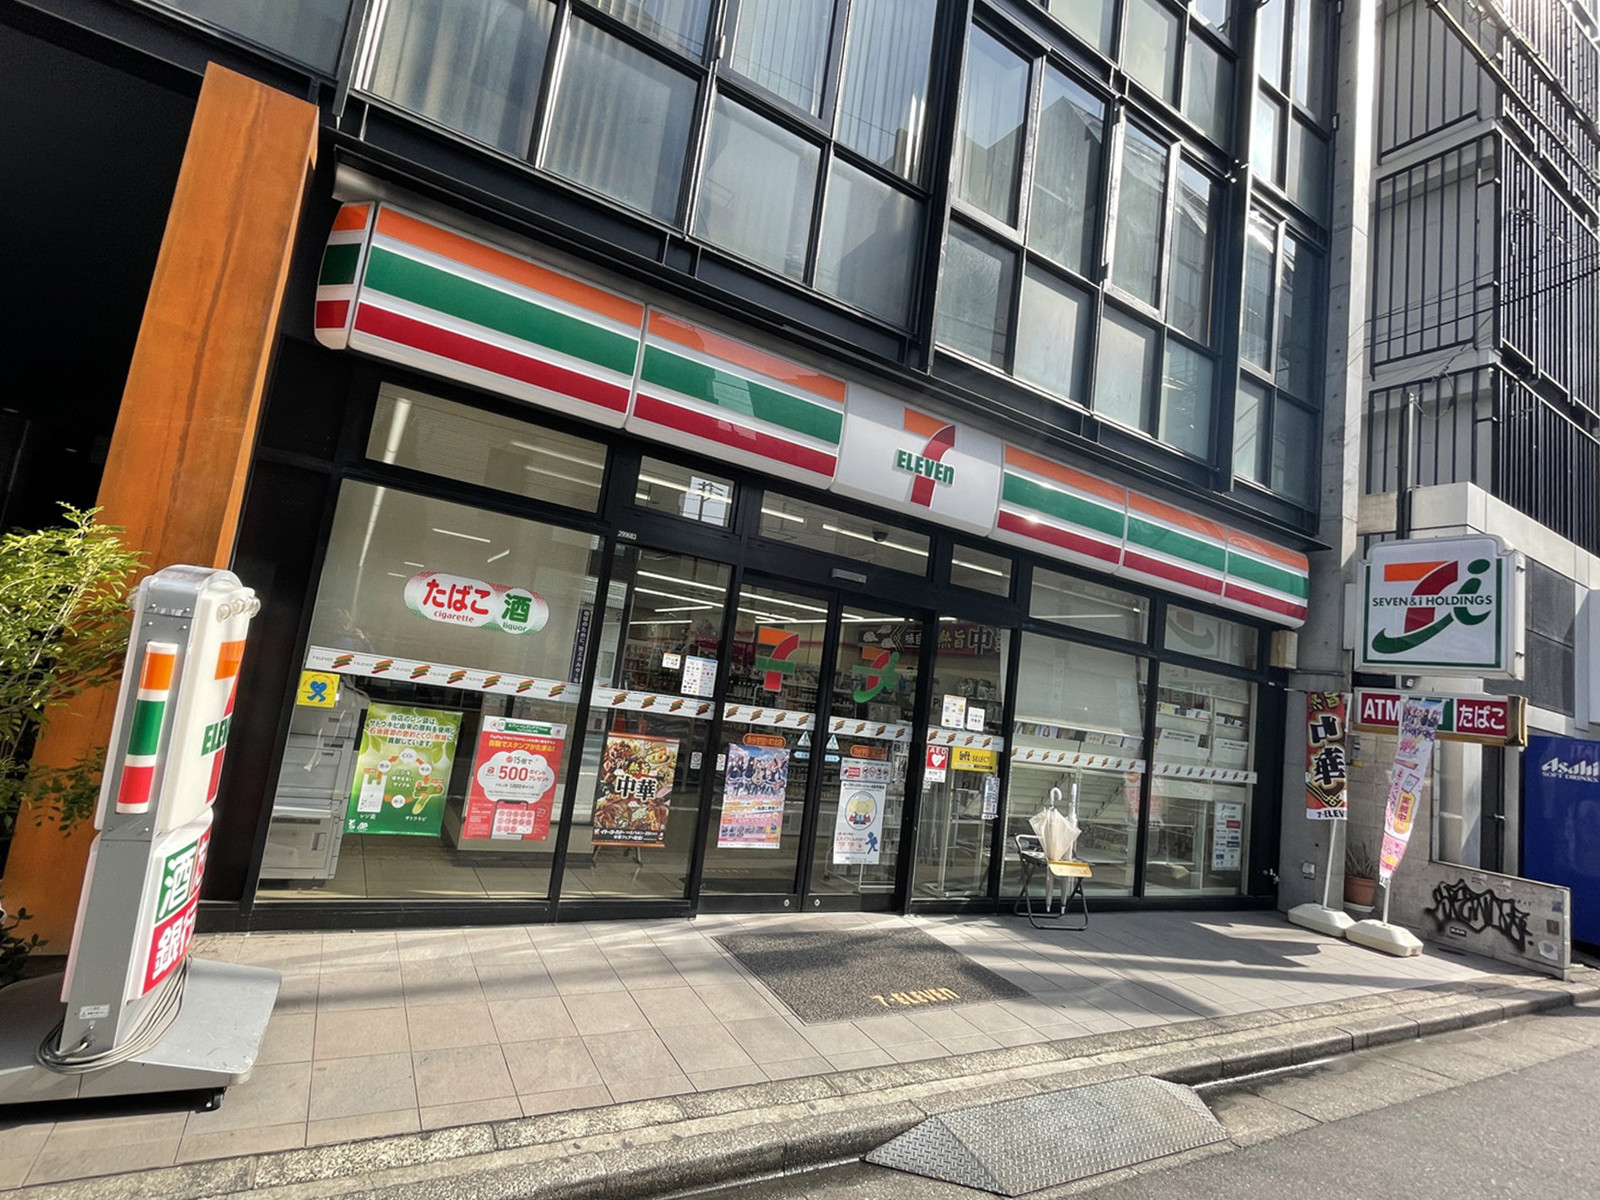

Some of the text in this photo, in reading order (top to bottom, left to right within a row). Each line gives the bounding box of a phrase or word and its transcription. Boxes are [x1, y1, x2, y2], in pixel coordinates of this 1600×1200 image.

[423, 579, 491, 615] たばこ
[501, 593, 532, 623] 酒
[1426, 595, 1493, 605] HOLDINGS
[434, 610, 475, 623] cigarette
[502, 621, 527, 632] liquor
[1363, 698, 1400, 721] ATM
[1459, 704, 1506, 730] たばこ
[929, 746, 949, 755] AED
[1309, 715, 1345, 786] 中華
[498, 765, 529, 781] 500
[1541, 757, 1599, 777] Asahi
[616, 775, 657, 801] 中華
[158, 845, 197, 919] 酒
